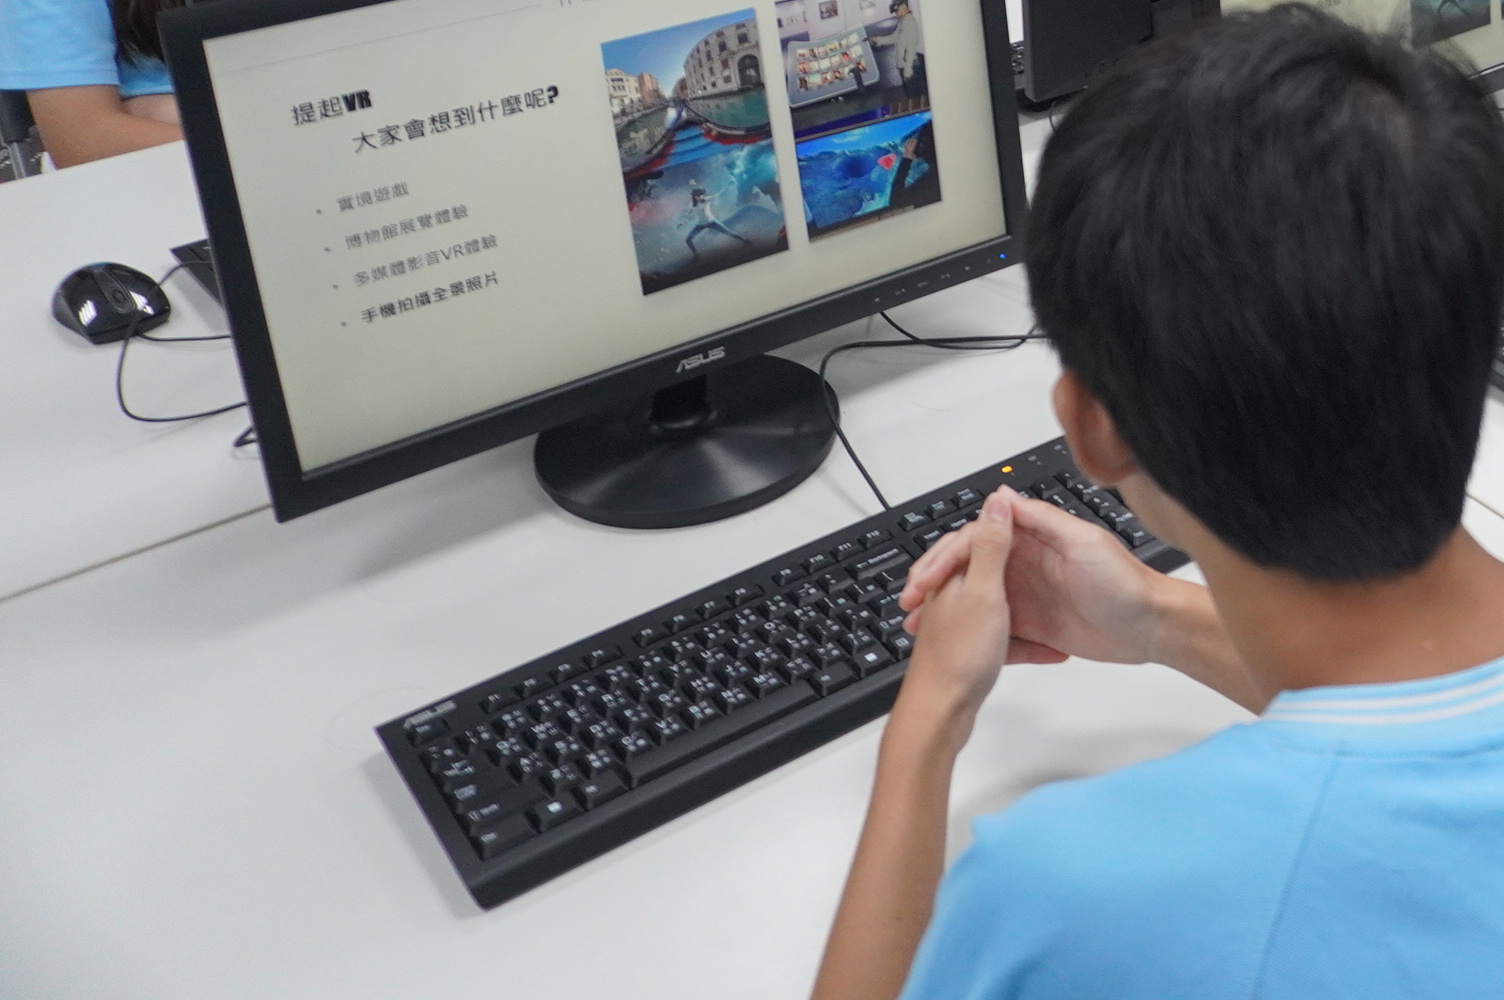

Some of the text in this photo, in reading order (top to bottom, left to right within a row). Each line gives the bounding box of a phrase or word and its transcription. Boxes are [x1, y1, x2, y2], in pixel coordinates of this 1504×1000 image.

[290, 89, 374, 129] 提起VR
[351, 84, 560, 154] 大家會想到什麼呢?
[336, 181, 410, 212] 實境遊戲
[344, 204, 469, 251] 博物館展覽體驗
[353, 234, 498, 287] 多媒體影音VR體驗
[361, 271, 499, 323] 手機拍攝全景照片
[676, 346, 726, 374] ASUS
